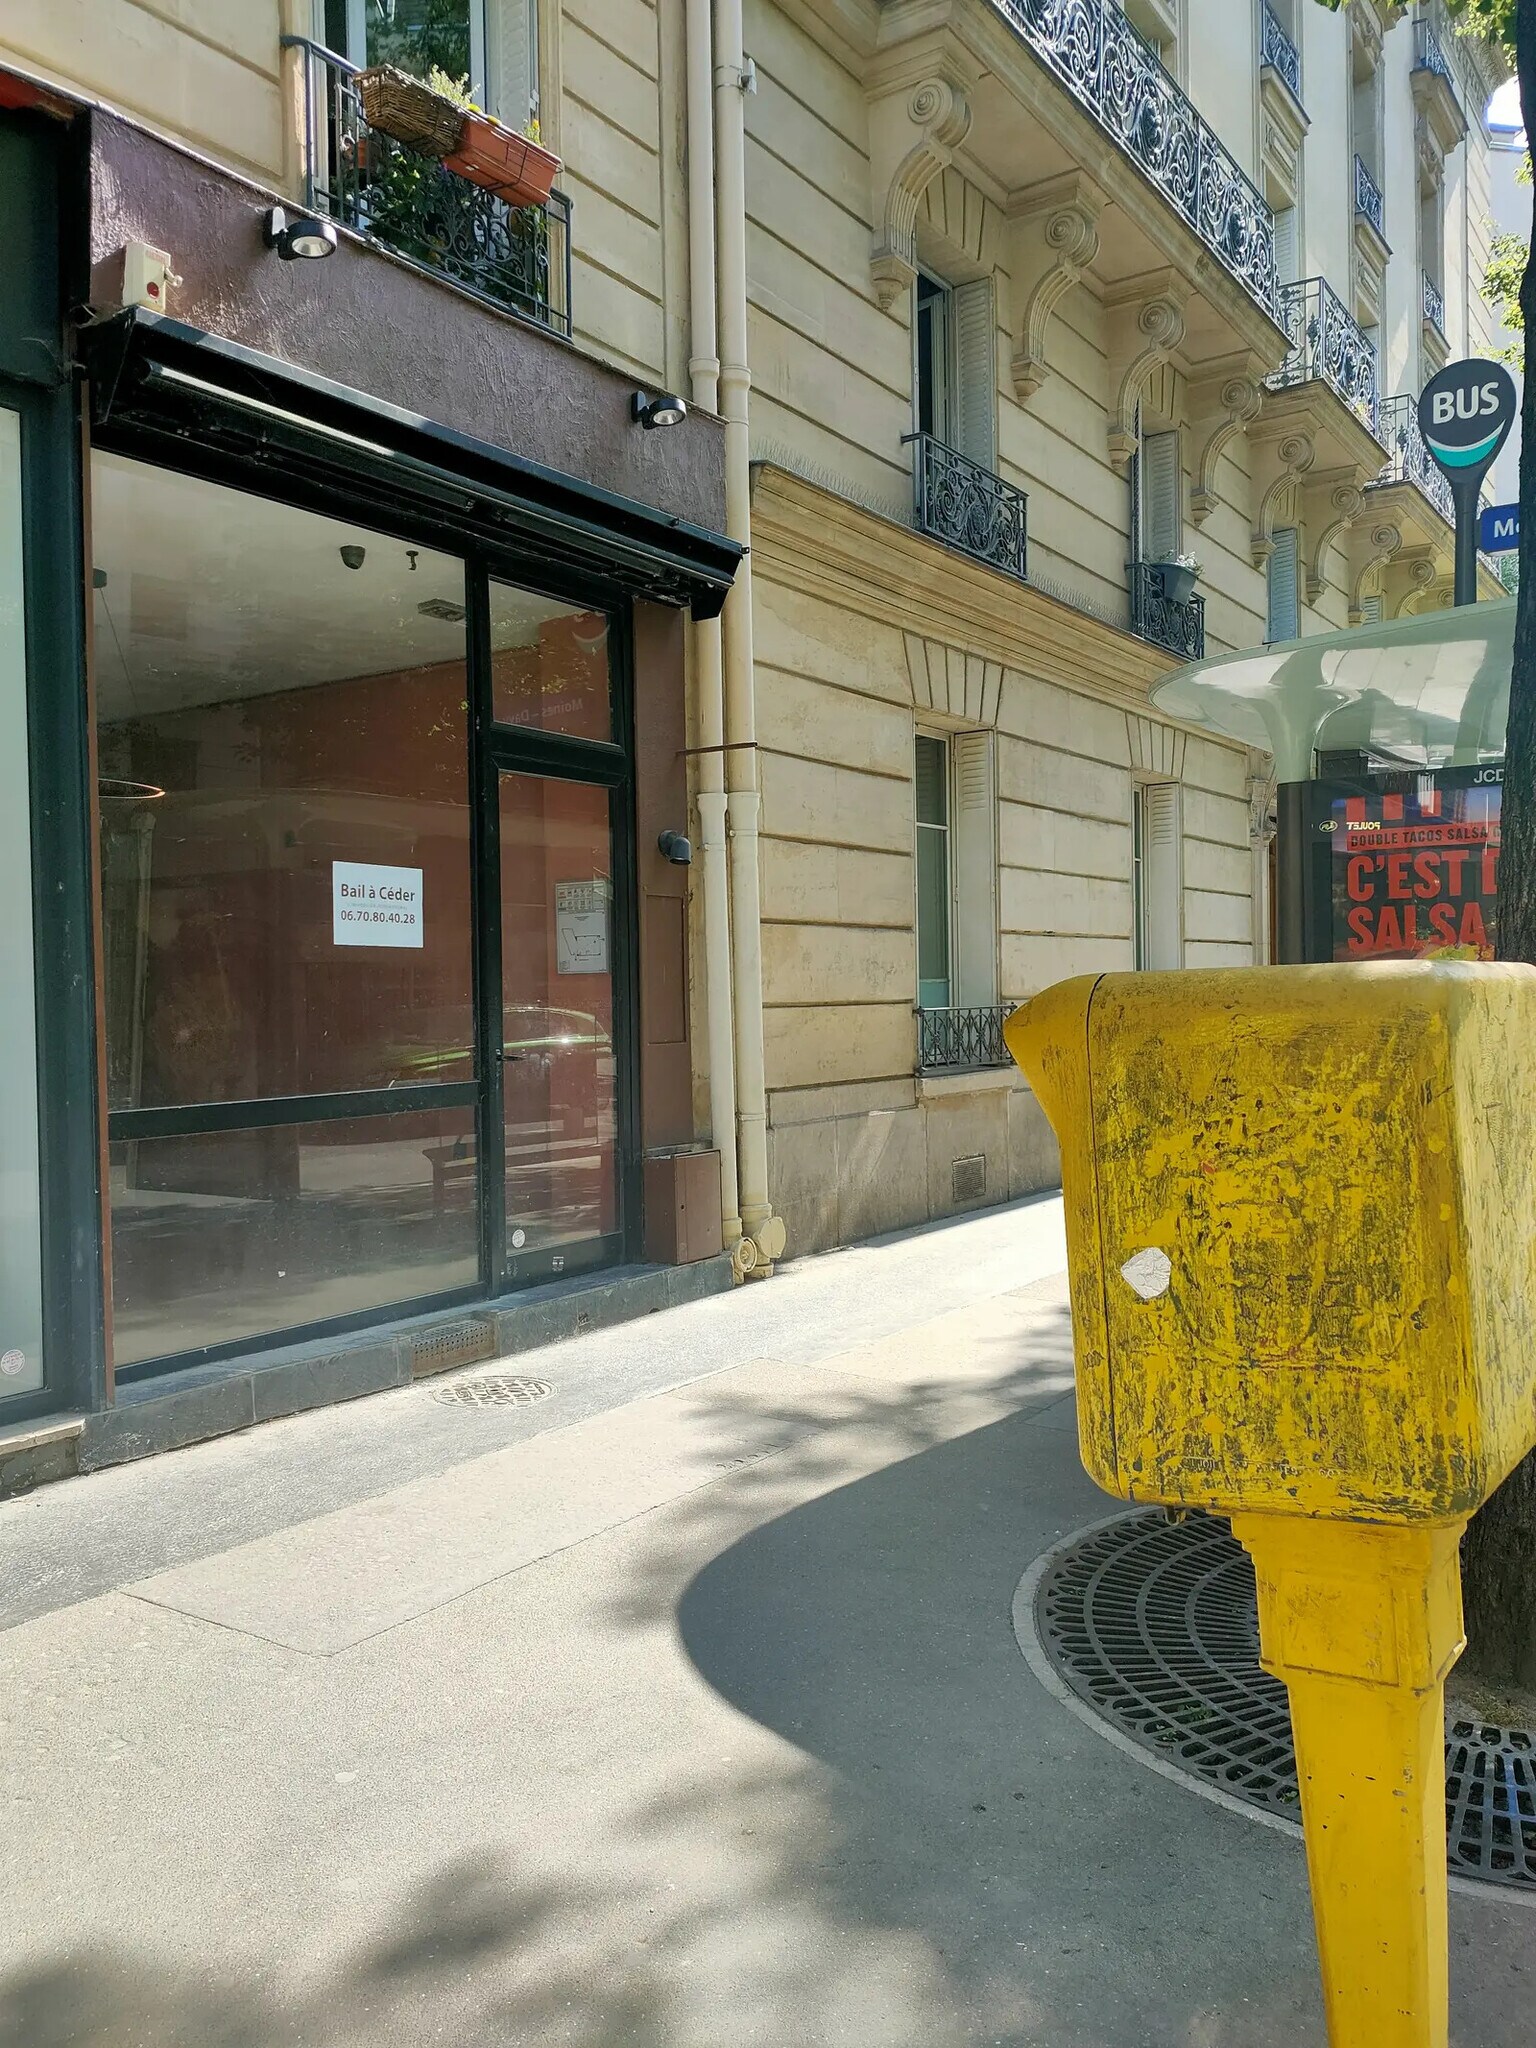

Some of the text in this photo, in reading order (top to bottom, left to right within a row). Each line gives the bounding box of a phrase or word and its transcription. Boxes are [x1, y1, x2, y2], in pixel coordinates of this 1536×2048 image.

[1432, 381, 1500, 425] BUS
[1493, 517, 1520, 538] M
[1351, 831, 1398, 847] DOUBLE
[1403, 829, 1442, 844] TACOS
[1447, 826, 1488, 841] SALSA
[1348, 850, 1469, 902] C'EST
[341, 883, 416, 902] Bail à Céder
[341, 909, 415, 925] 06.70.80.40.28
[1347, 902, 1487, 954] SALSA
